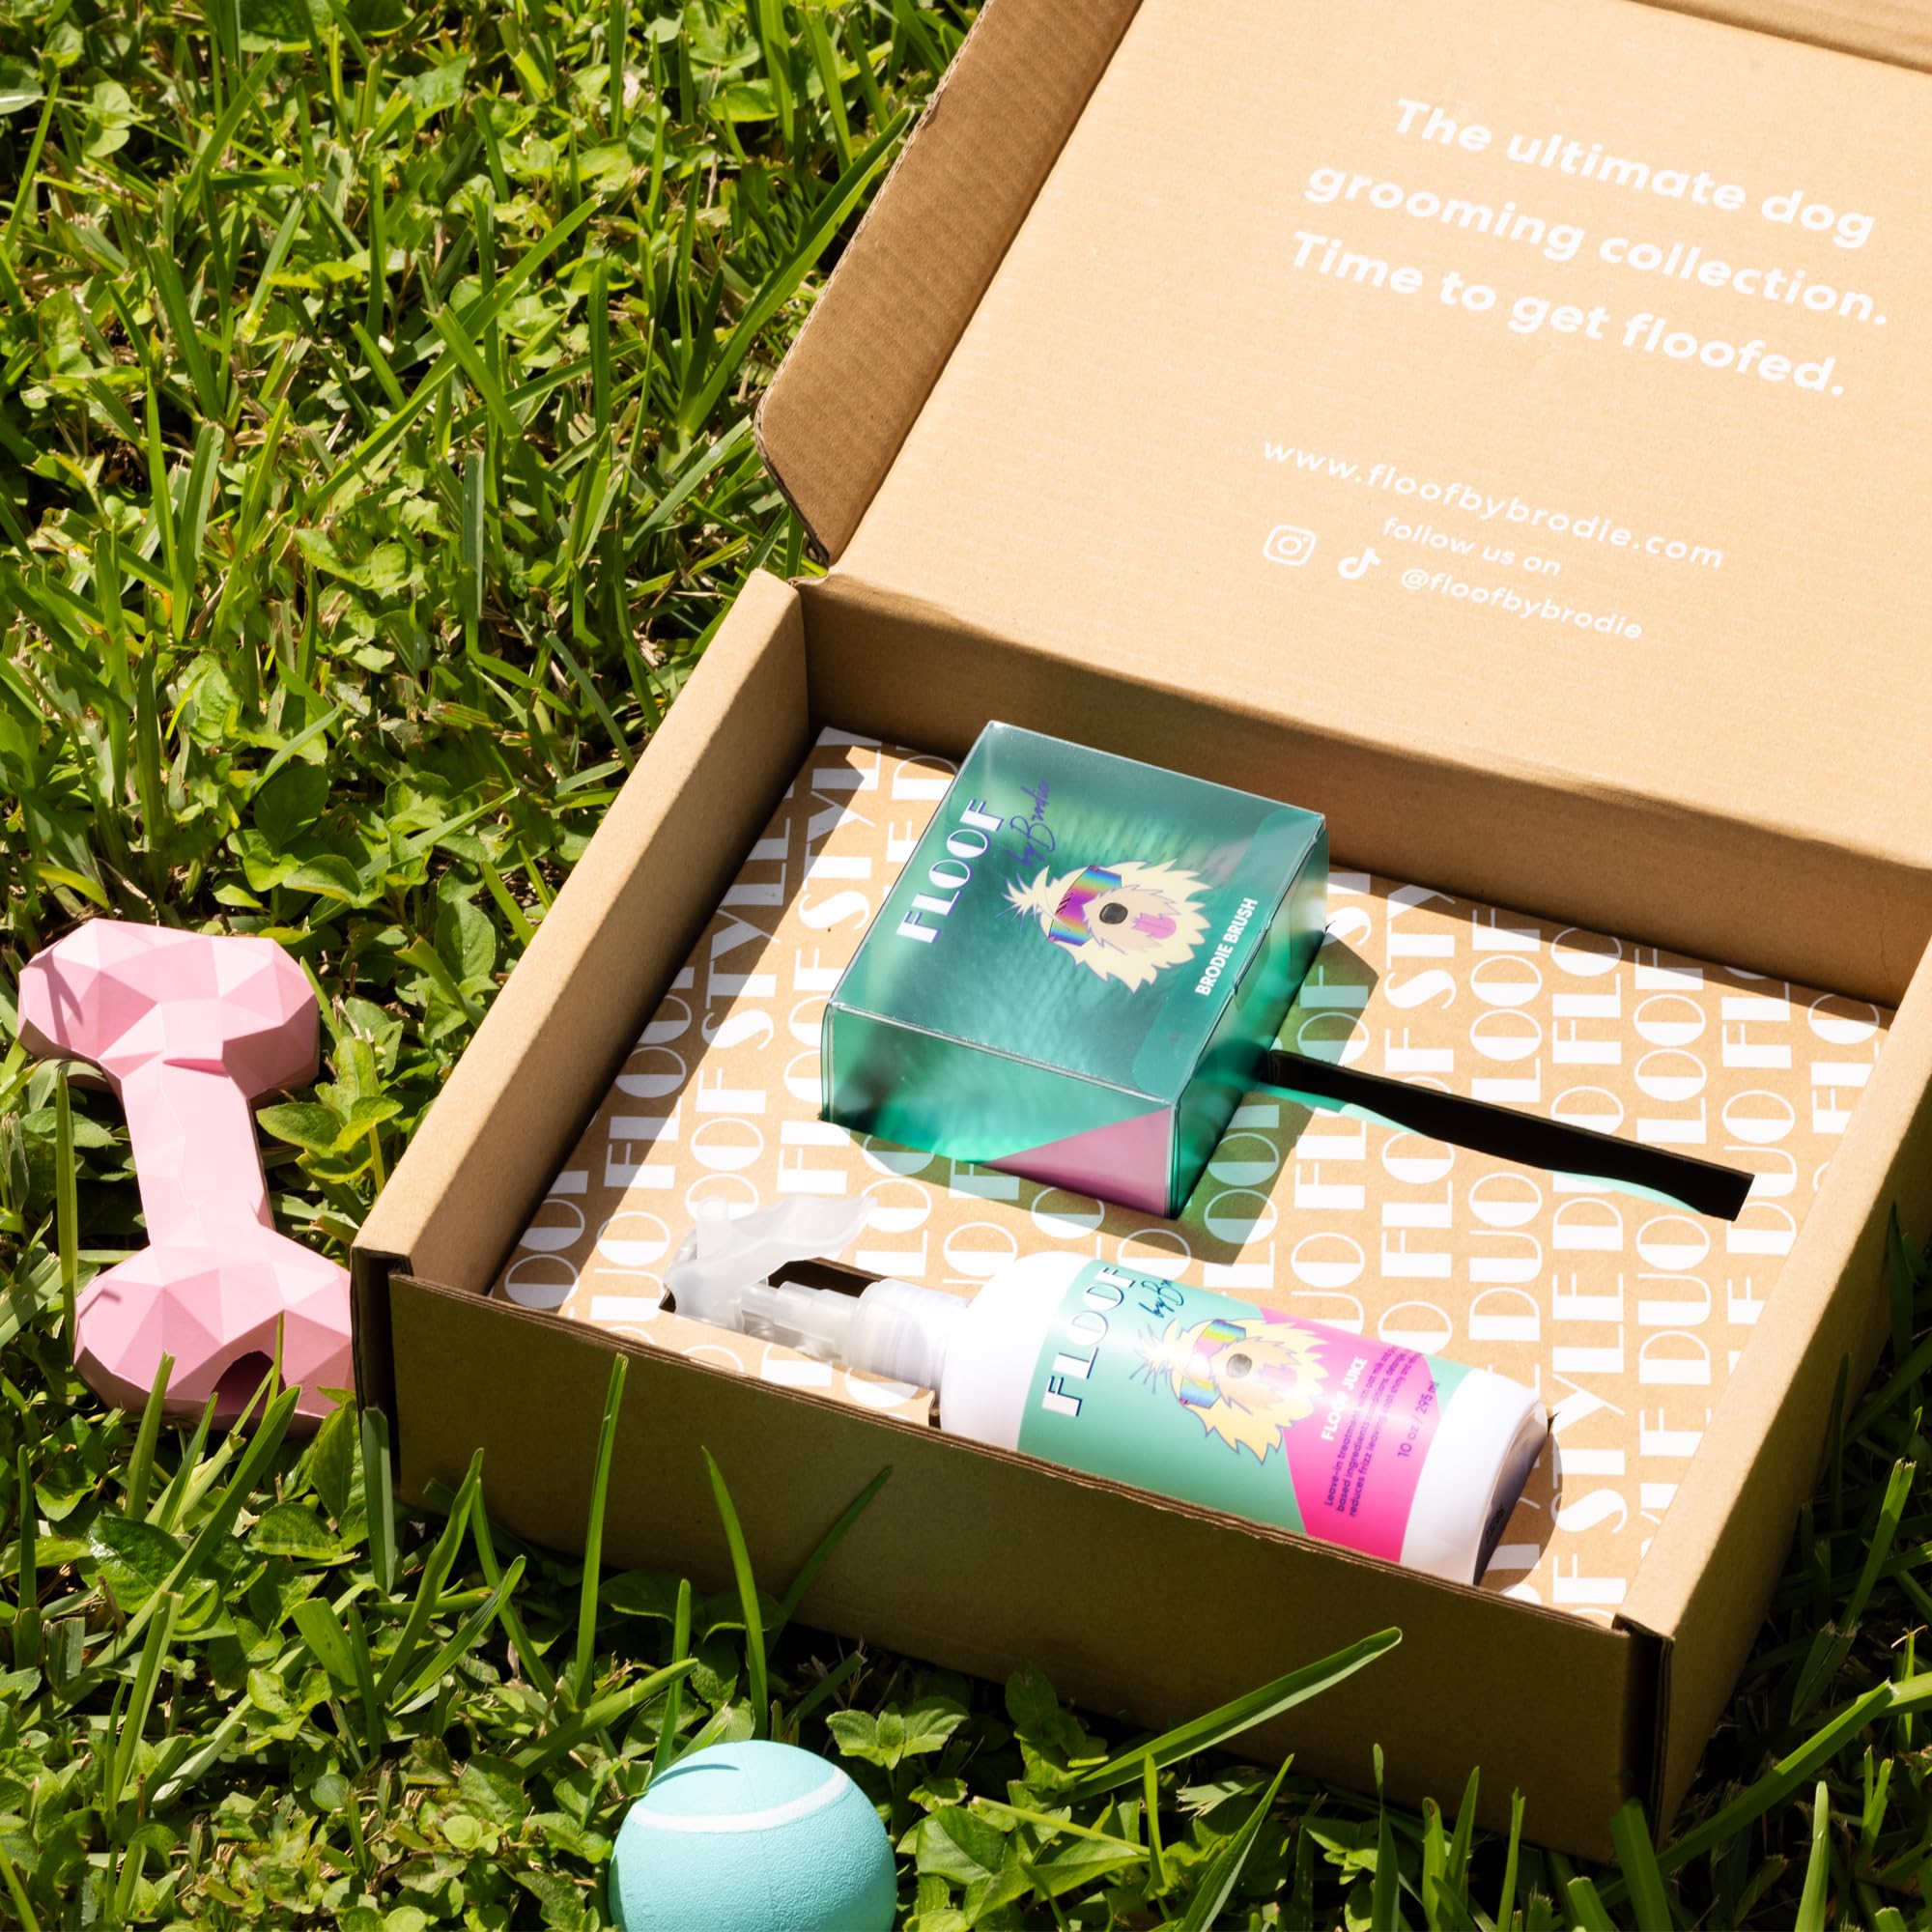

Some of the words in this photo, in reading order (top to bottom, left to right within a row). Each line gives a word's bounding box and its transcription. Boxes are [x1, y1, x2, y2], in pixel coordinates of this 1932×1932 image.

[1397, 99, 1492, 152] The
[1507, 134, 1747, 211] ultimate
[1761, 189, 1875, 249] dog
[1293, 231, 1423, 295] Time
[1439, 271, 1496, 311] to
[1507, 297, 1610, 340] get
[1622, 312, 1843, 395] floofed.
[1304, 168, 1585, 262] grooming
[1599, 238, 1887, 326] collection.
[1263, 441, 1723, 568] www.floofbybrodie.com
[1382, 516, 1475, 554] follow
[1483, 546, 1516, 565] us
[1522, 555, 1561, 576] on
[1401, 568, 1642, 639] @floofbybrodie
[895, 799, 1005, 943] FLOOF
[1194, 943, 1234, 997] BRODIE
[1222, 897, 1258, 944] BRUSH
[1721, 1091, 1798, 1257] DUO
[1467, 1172, 1544, 1344] DUO
[1634, 1215, 1712, 1386] DUO
[1041, 1267, 1136, 1417] FLOOF
[1321, 1390, 1350, 1442] FLOOF
[1342, 1356, 1369, 1391] JUICE
[1549, 1272, 1628, 1536] STYLE
[1324, 1461, 1344, 1506] Leave-in
[1337, 1478, 1351, 1513] based
[1346, 1420, 1371, 1478] ingredients
[1350, 1474, 1366, 1518] reduces
[1358, 1453, 1373, 1475] frizz
[1397, 1441, 1413, 1458] 10
[1407, 1424, 1421, 1440] oz
[1415, 1391, 1434, 1415] 295
[1428, 1379, 1440, 1395] ml
